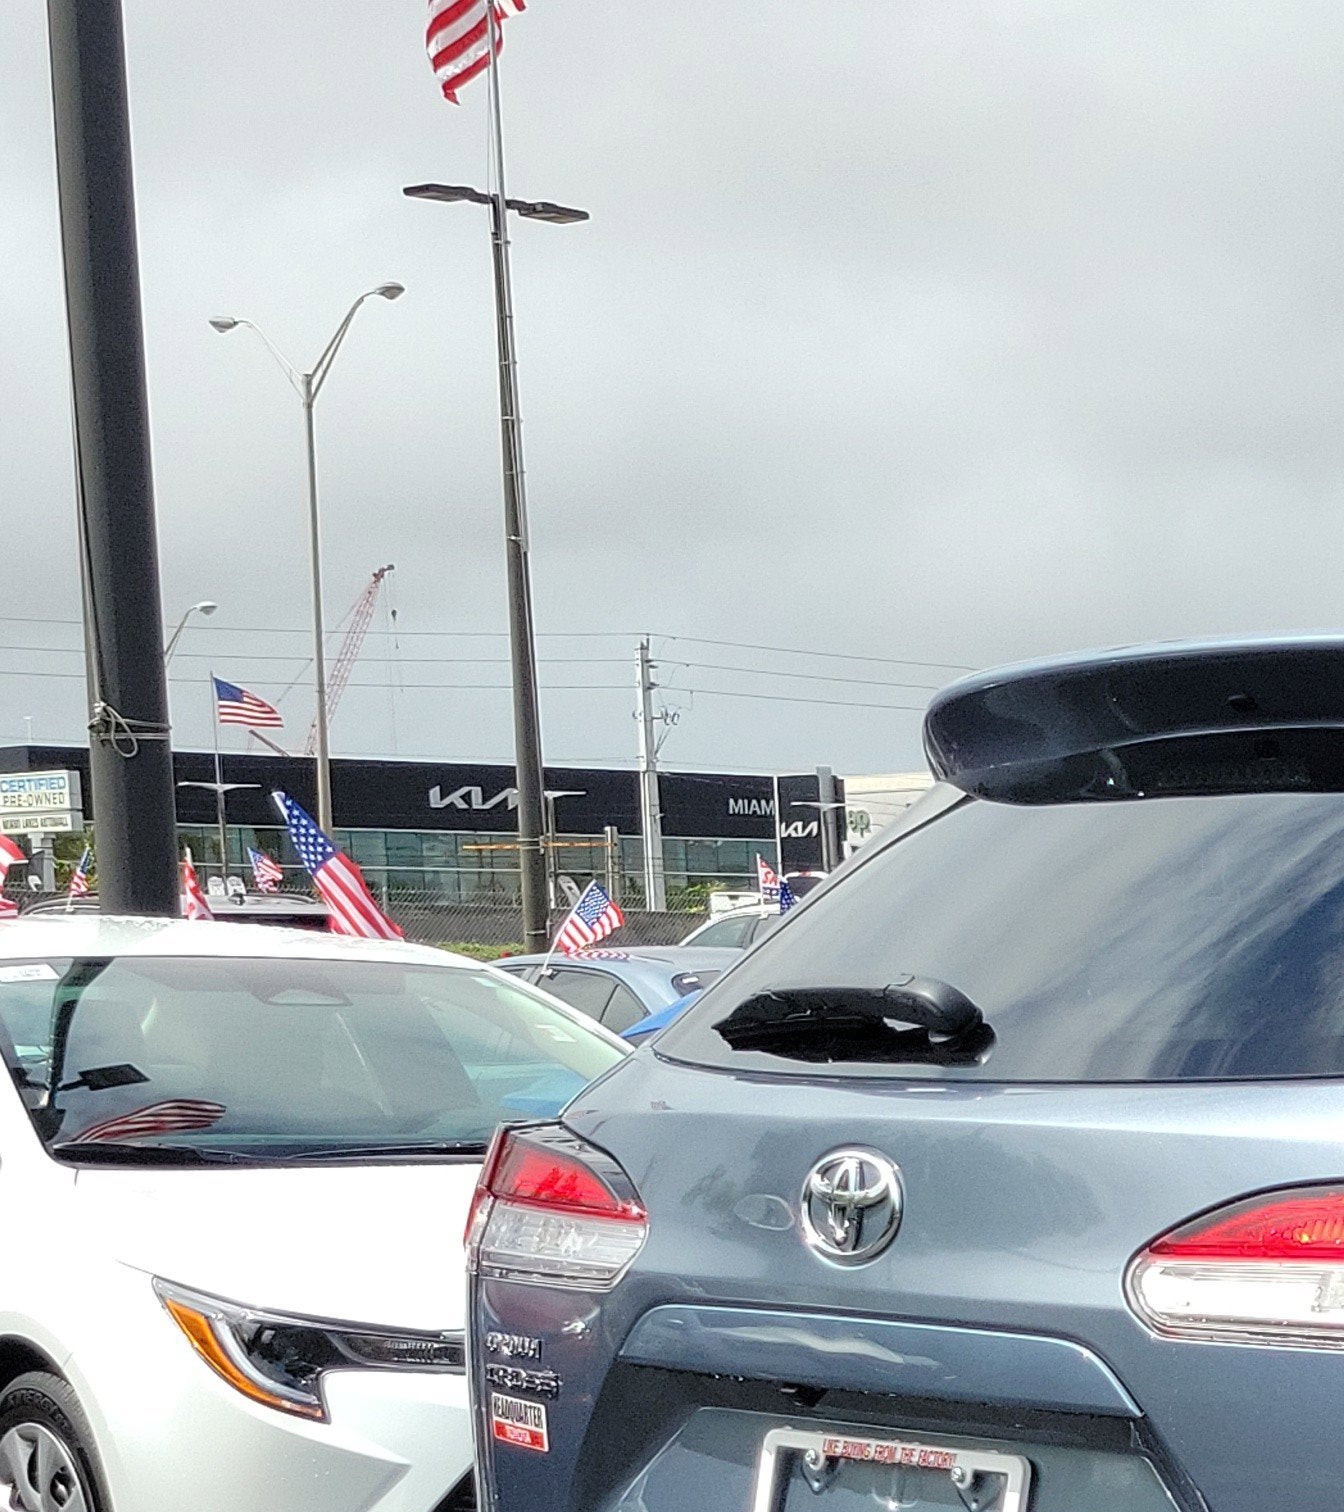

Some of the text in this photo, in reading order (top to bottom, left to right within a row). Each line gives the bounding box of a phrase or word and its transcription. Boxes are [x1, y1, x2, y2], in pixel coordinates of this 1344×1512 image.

[0, 776, 67, 793] CERTIFIED
[3, 792, 65, 807] PRE-OWNED
[728, 798, 775, 816] MIAM
[780, 821, 818, 838] KIA
[493, 1396, 545, 1430] HEADQUARTER
